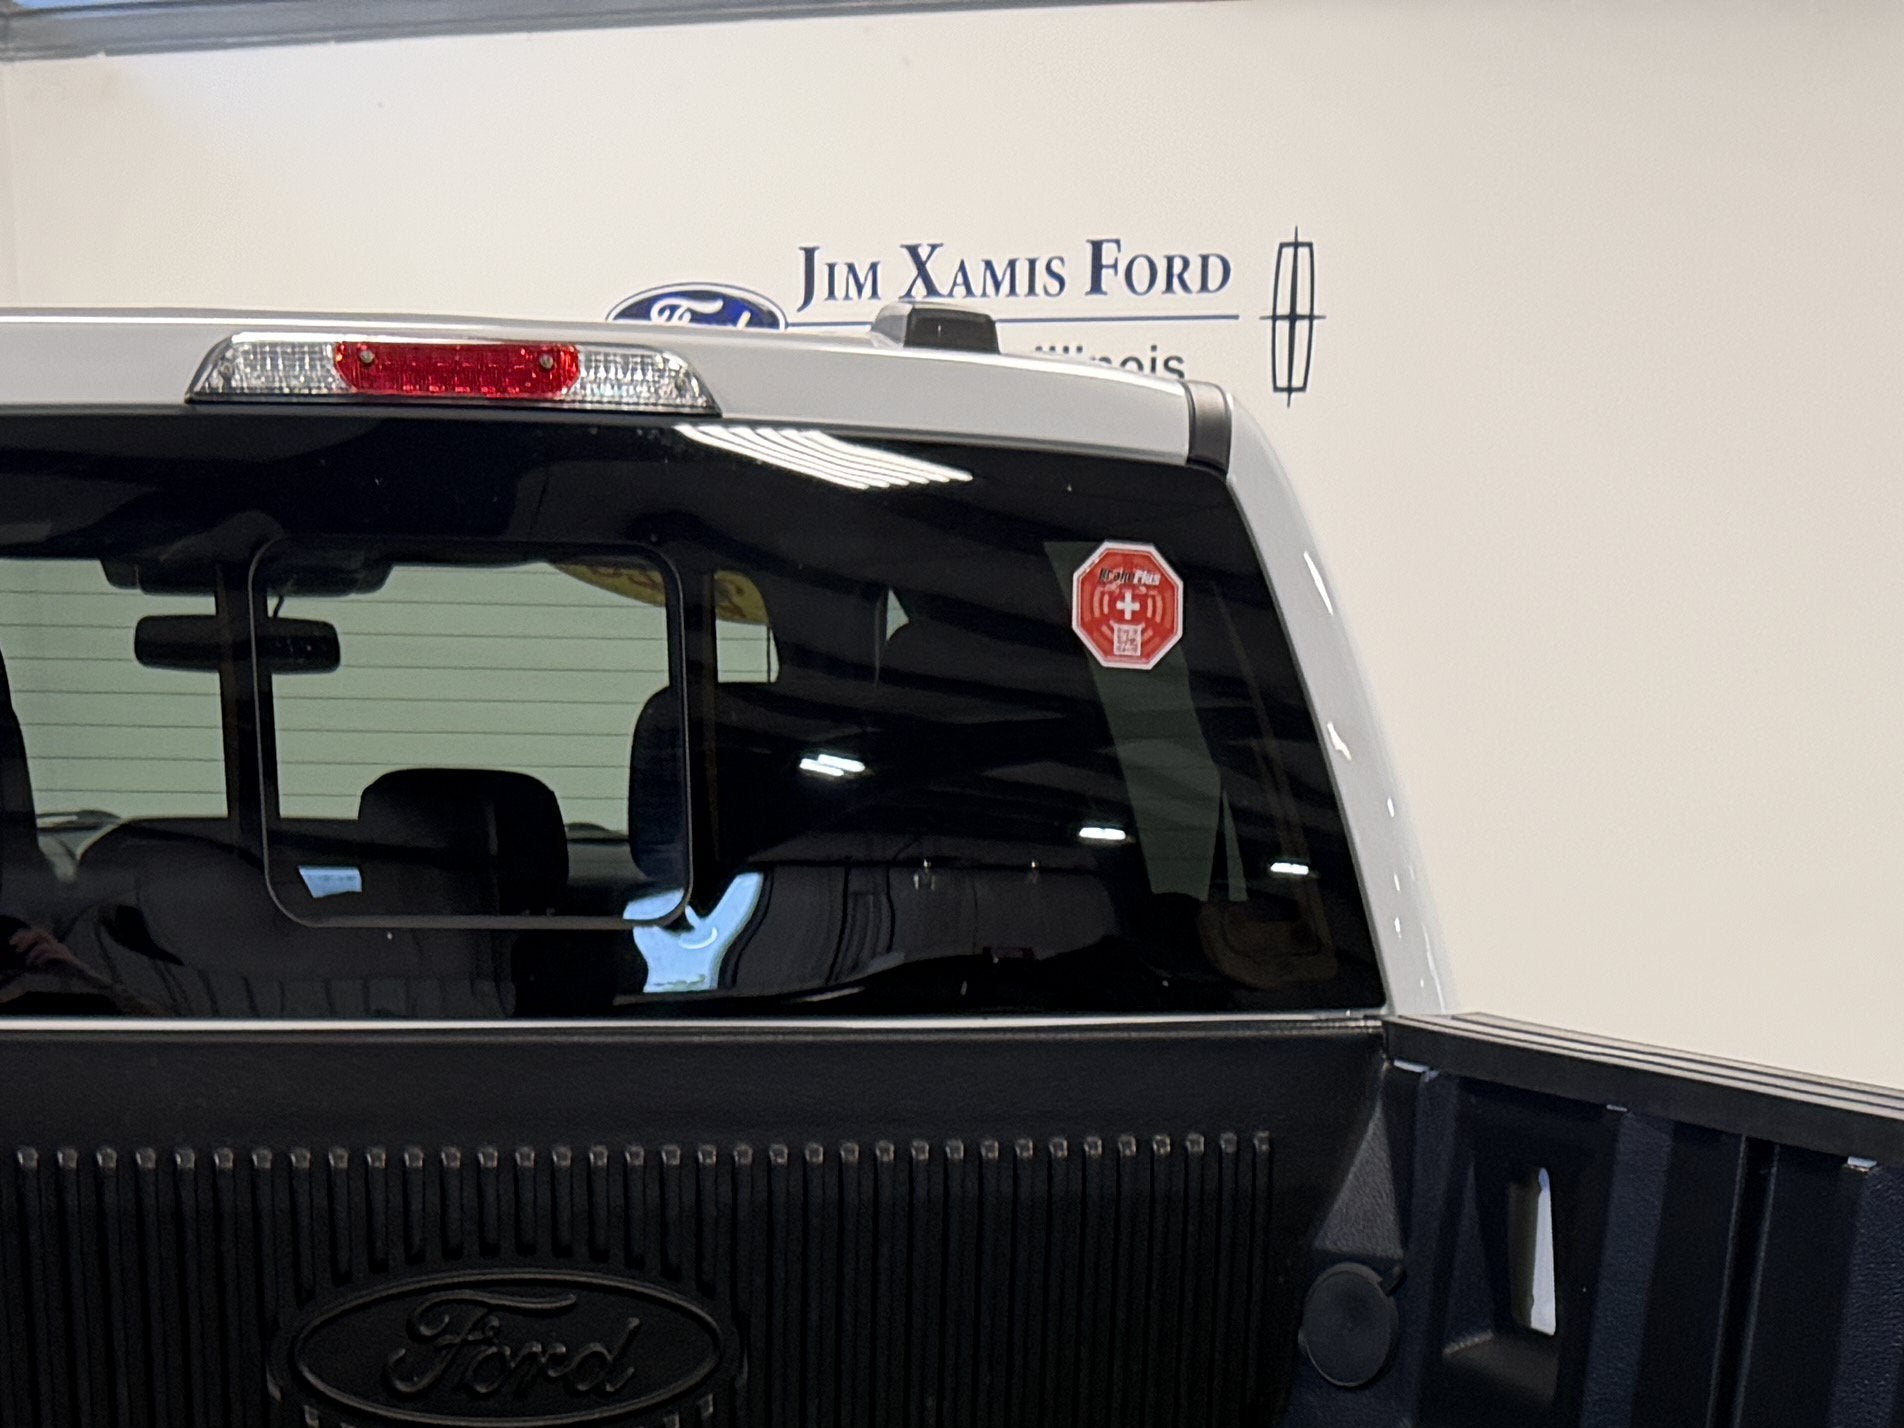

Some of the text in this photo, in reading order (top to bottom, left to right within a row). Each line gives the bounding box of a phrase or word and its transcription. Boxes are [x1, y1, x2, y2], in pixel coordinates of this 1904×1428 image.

[798, 239, 1232, 313] JIM XAMIS FORD
[388, 1289, 641, 1395] Ford
